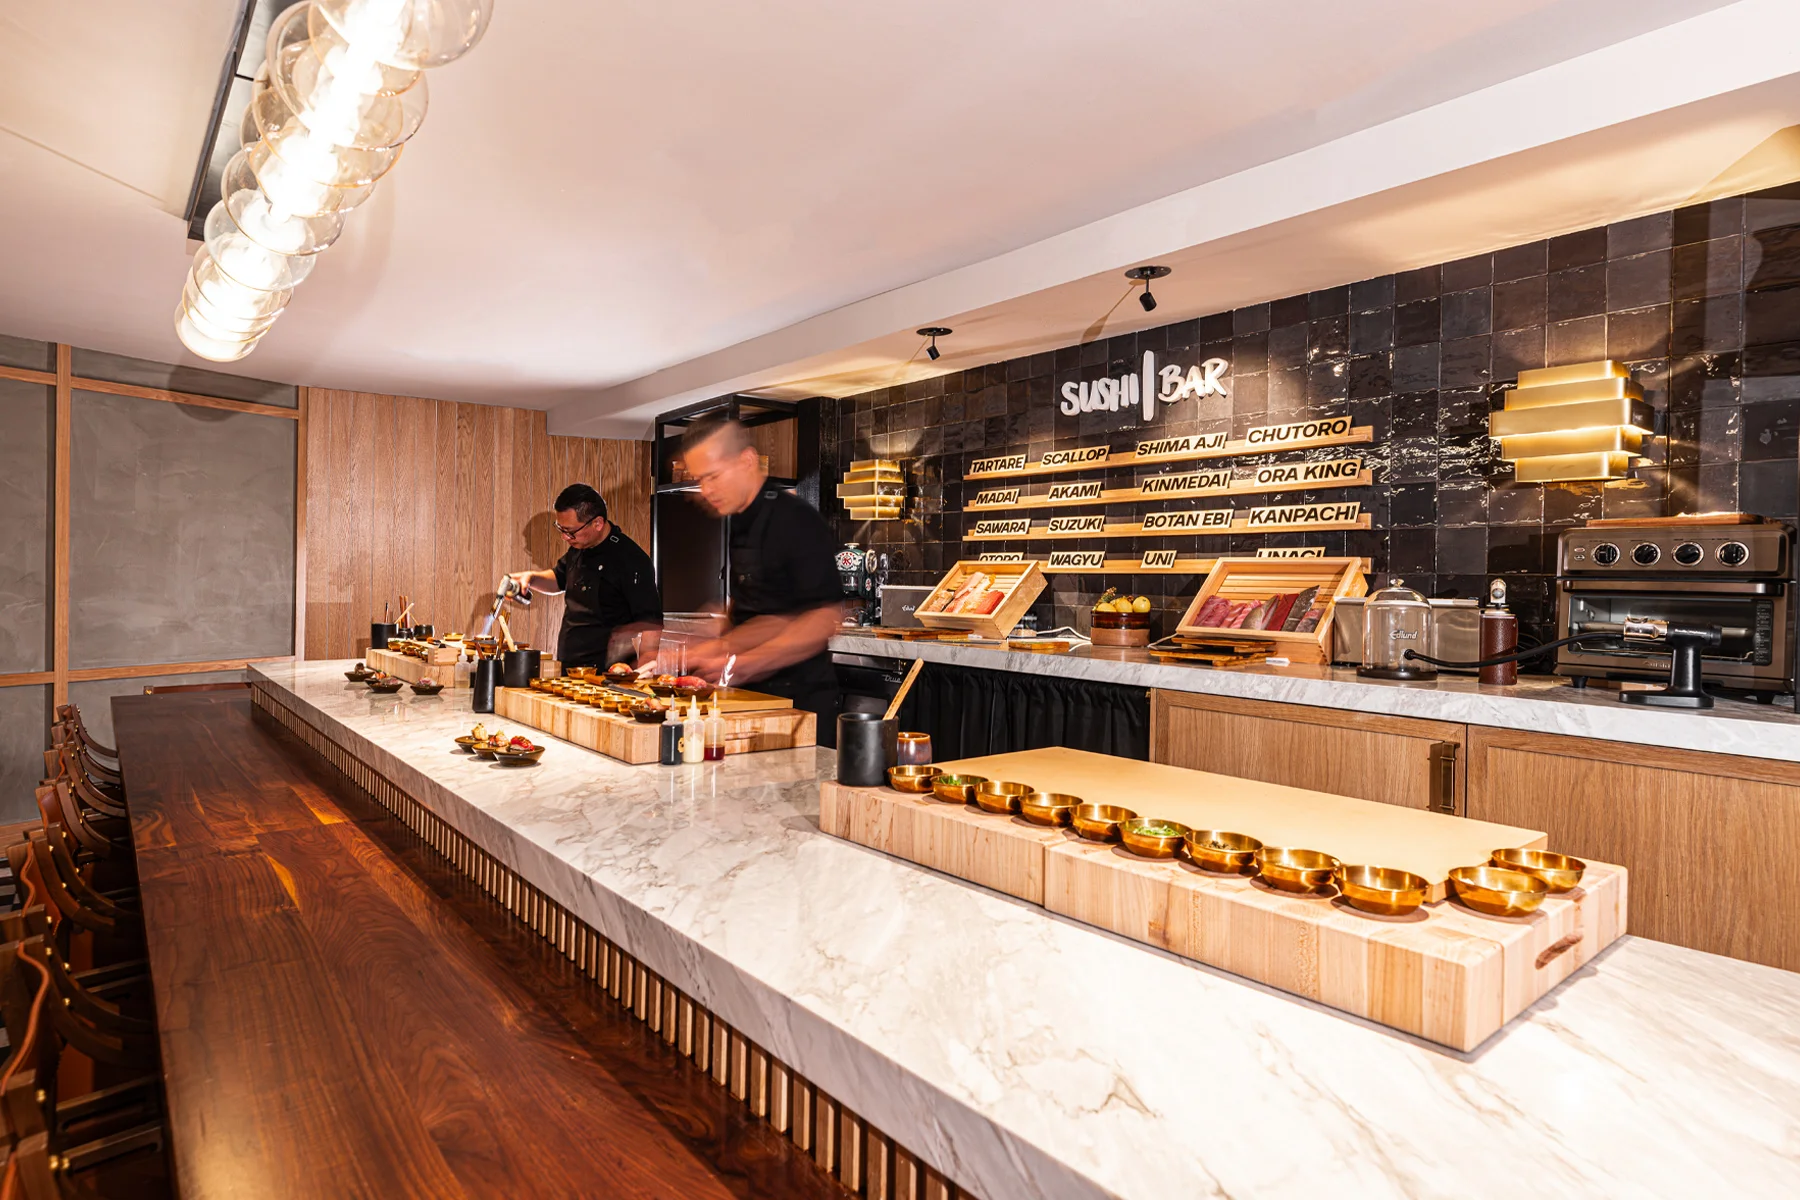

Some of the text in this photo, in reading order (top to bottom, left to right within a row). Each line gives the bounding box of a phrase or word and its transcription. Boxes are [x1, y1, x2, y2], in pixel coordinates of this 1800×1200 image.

[1061, 357, 1228, 416] SUSHI BAR
[1248, 420, 1348, 443] CHUTORO
[1137, 435, 1222, 455] SHIMA AJI
[1043, 448, 1107, 465] SCALLOP
[972, 457, 1023, 473] TARTARE
[1257, 462, 1360, 483] ORA KING
[1141, 473, 1229, 493] KINMEDAI
[976, 491, 1017, 504] MADAI
[1049, 484, 1100, 499] AKAMI
[1144, 512, 1231, 528] BOTAN EBI
[1250, 505, 1358, 525] KANPACHI
[976, 521, 1026, 533] SAWARA
[1050, 518, 1103, 531] SUZUKI
[1050, 554, 1103, 566] WAGYU
[1144, 552, 1174, 565] UNI
[1389, 630, 1418, 640] Edlund
